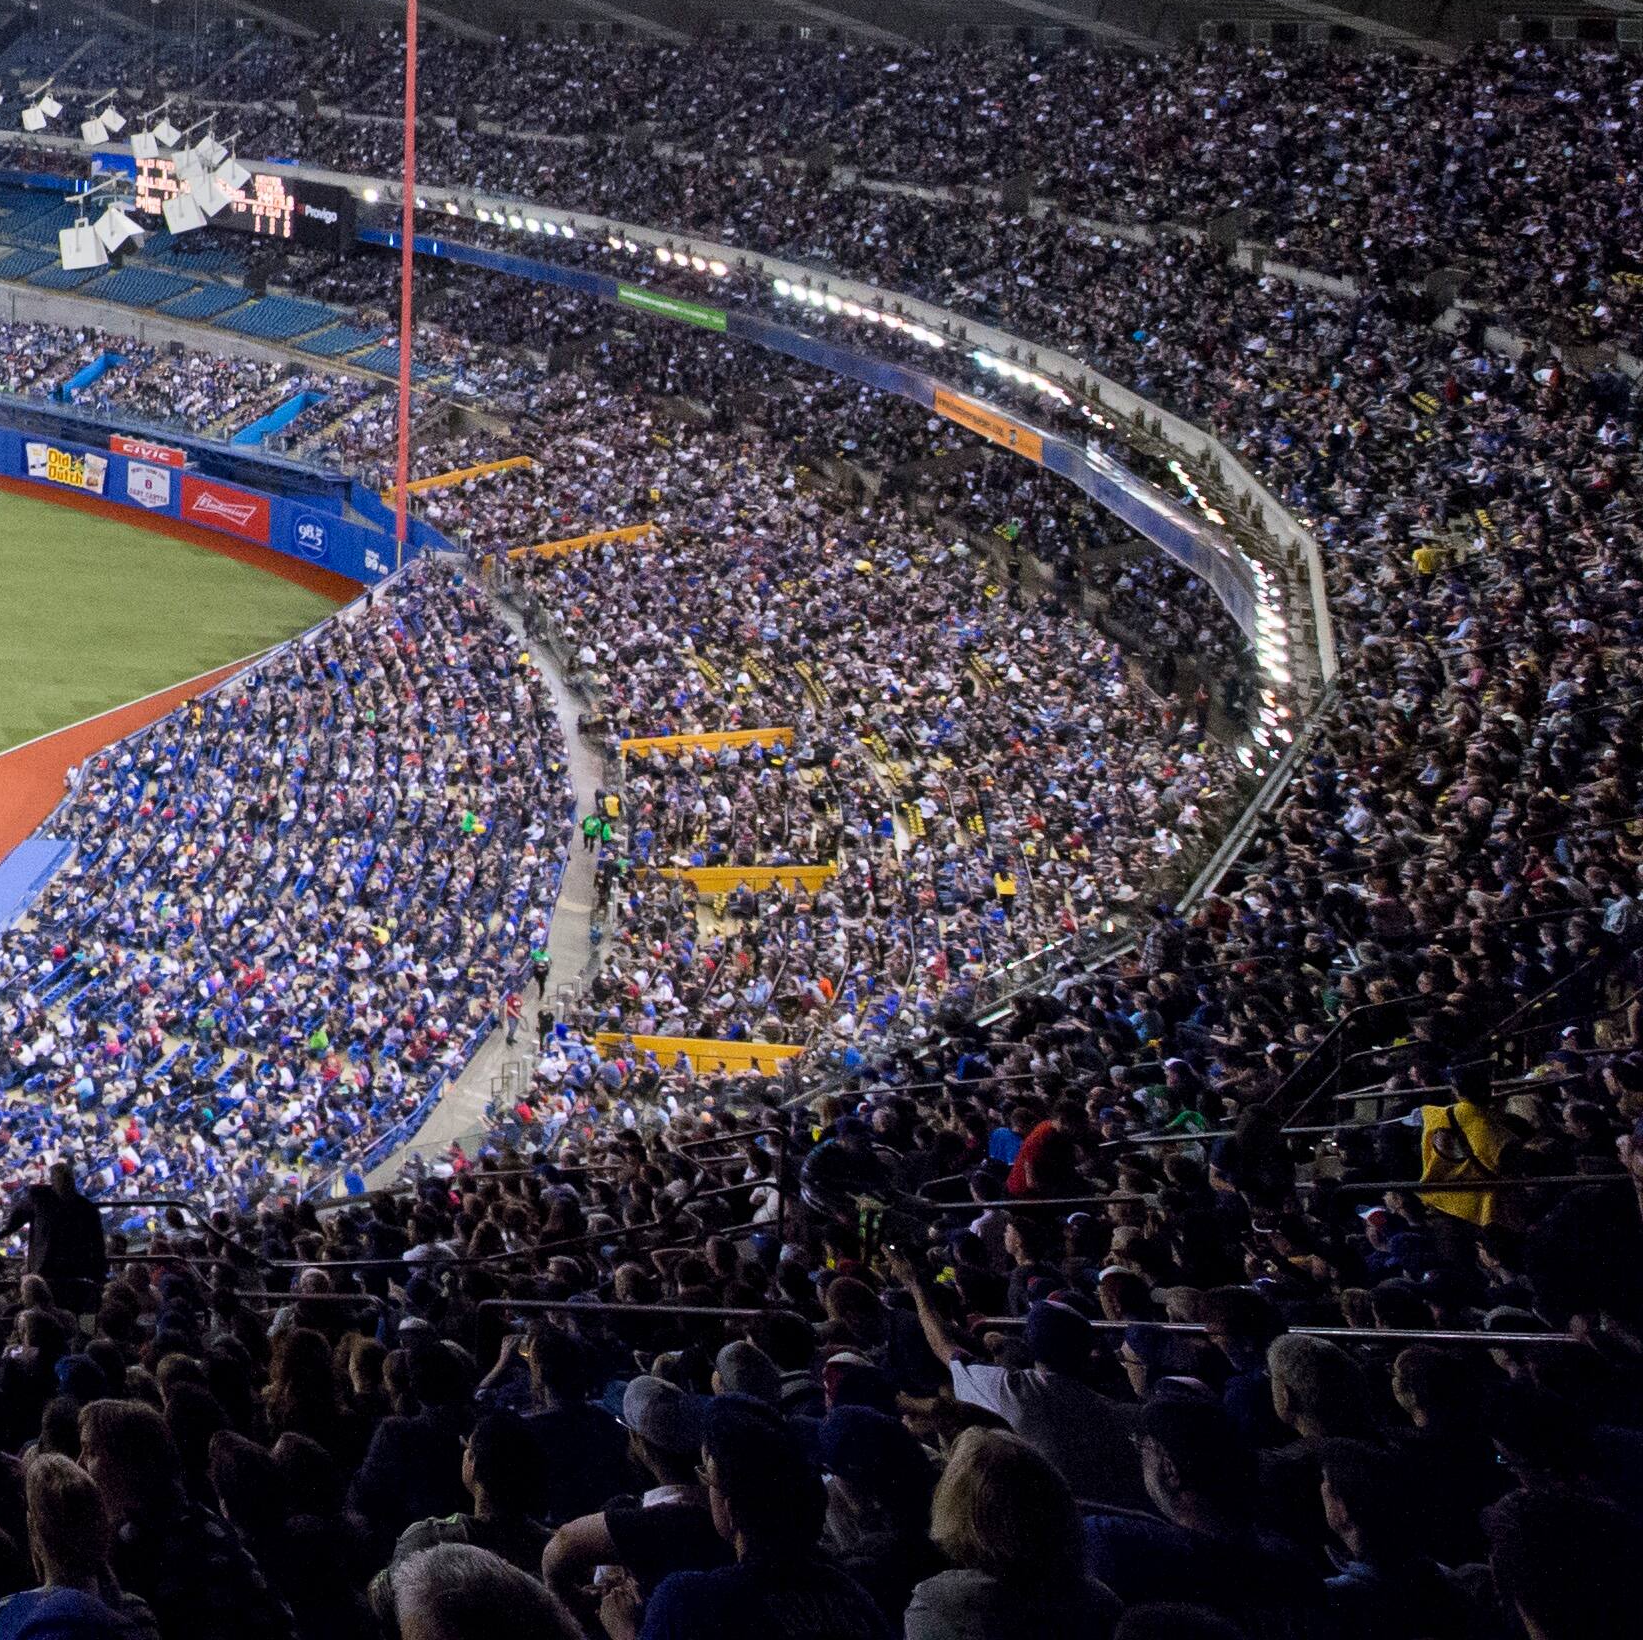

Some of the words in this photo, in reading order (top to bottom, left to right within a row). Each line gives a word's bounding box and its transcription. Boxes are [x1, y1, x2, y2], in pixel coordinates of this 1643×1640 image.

[304, 205, 338, 224] Provigo
[48, 449, 71, 467] Old
[122, 443, 171, 460] civic
[48, 465, 83, 486] Dutch
